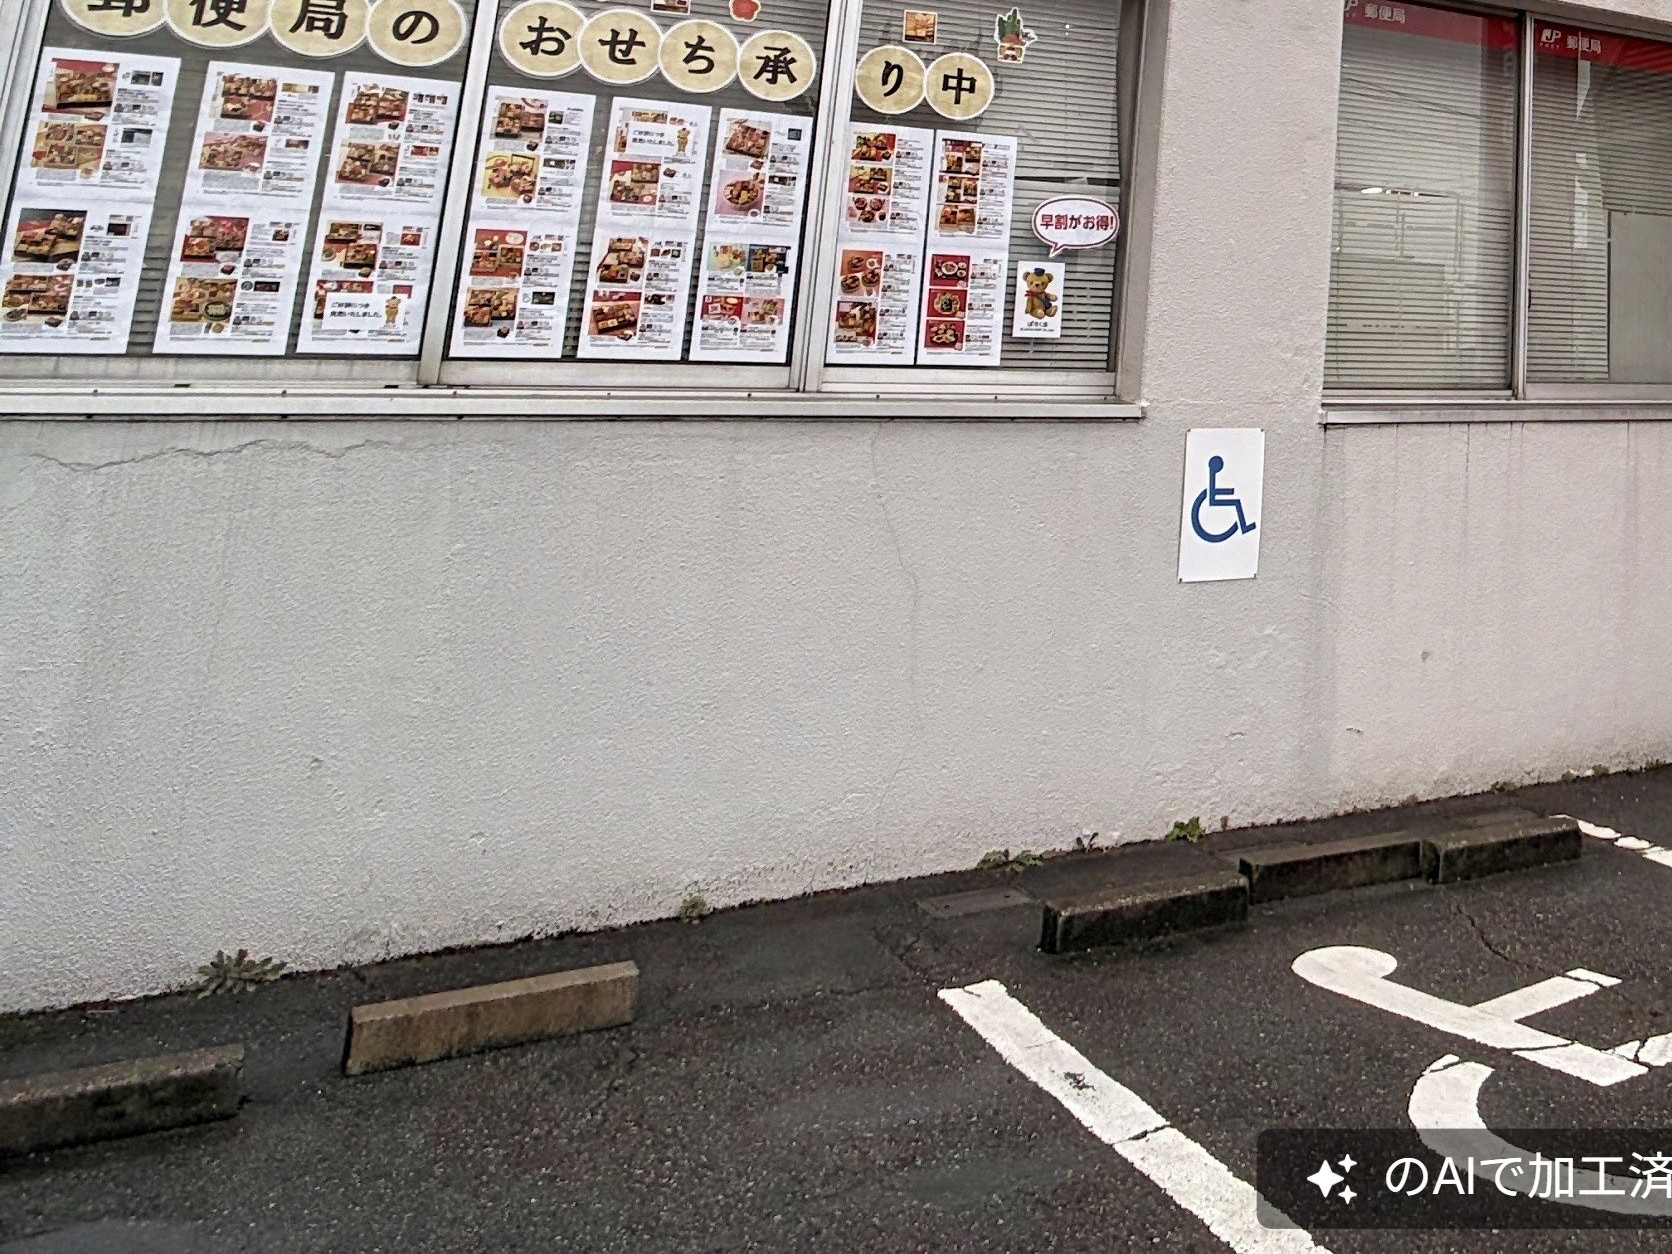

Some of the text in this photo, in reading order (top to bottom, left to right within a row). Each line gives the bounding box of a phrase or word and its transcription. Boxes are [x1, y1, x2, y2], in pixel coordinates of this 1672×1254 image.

[519, 15, 797, 85] おせち承
[881, 60, 977, 106] り中
[1040, 214, 1114, 230] 早割がお得!
